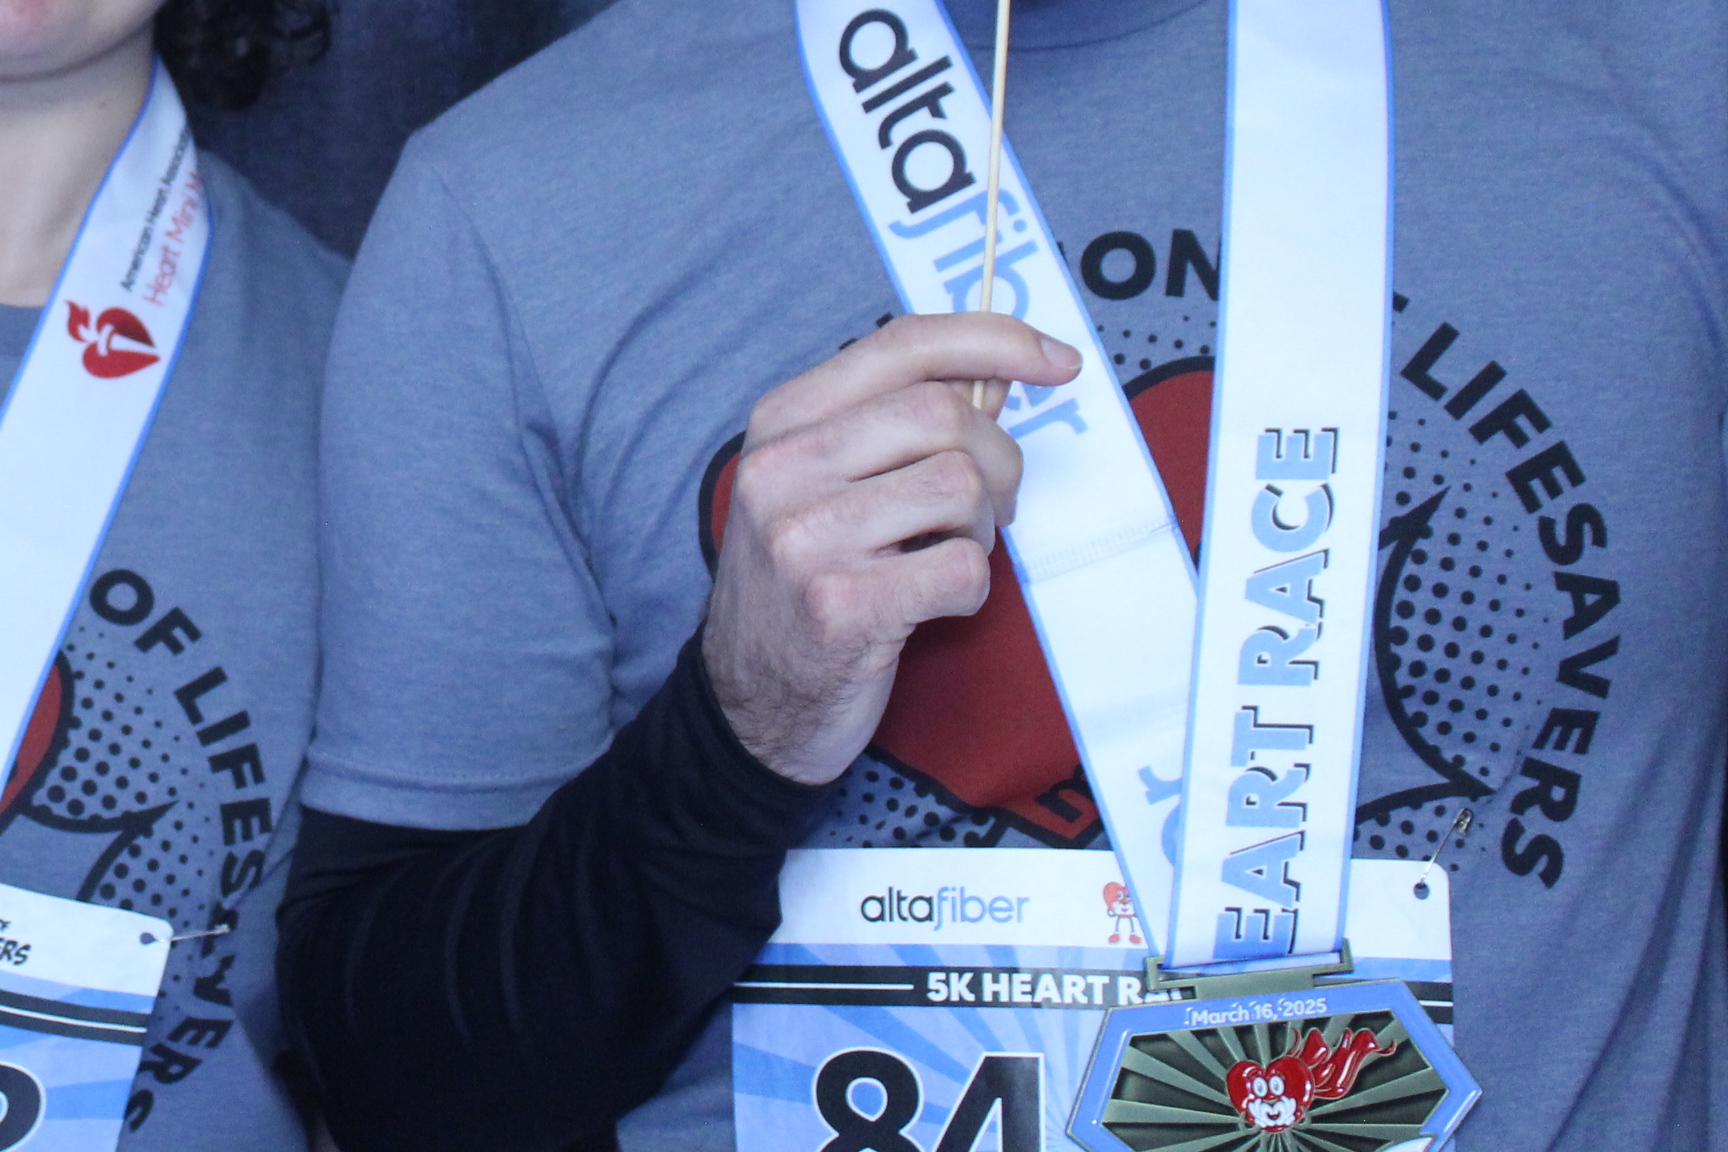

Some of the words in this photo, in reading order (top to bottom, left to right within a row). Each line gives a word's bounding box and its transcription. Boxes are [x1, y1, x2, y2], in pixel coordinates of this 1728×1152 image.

[119, 226, 153, 292] American
[146, 187, 168, 224] Heart
[143, 245, 182, 306] Heart
[1237, 427, 1340, 686] RACE
[89, 568, 203, 656] OF
[1399, 322, 1621, 889] LIFESAVERS
[1213, 705, 1314, 960] EART
[860, 886, 1030, 931] altafiber
[927, 971, 976, 1002] 5K
[983, 972, 1110, 1005] HEART
[1190, 1007, 1251, 1027] March
[1283, 998, 1328, 1016] 2025
